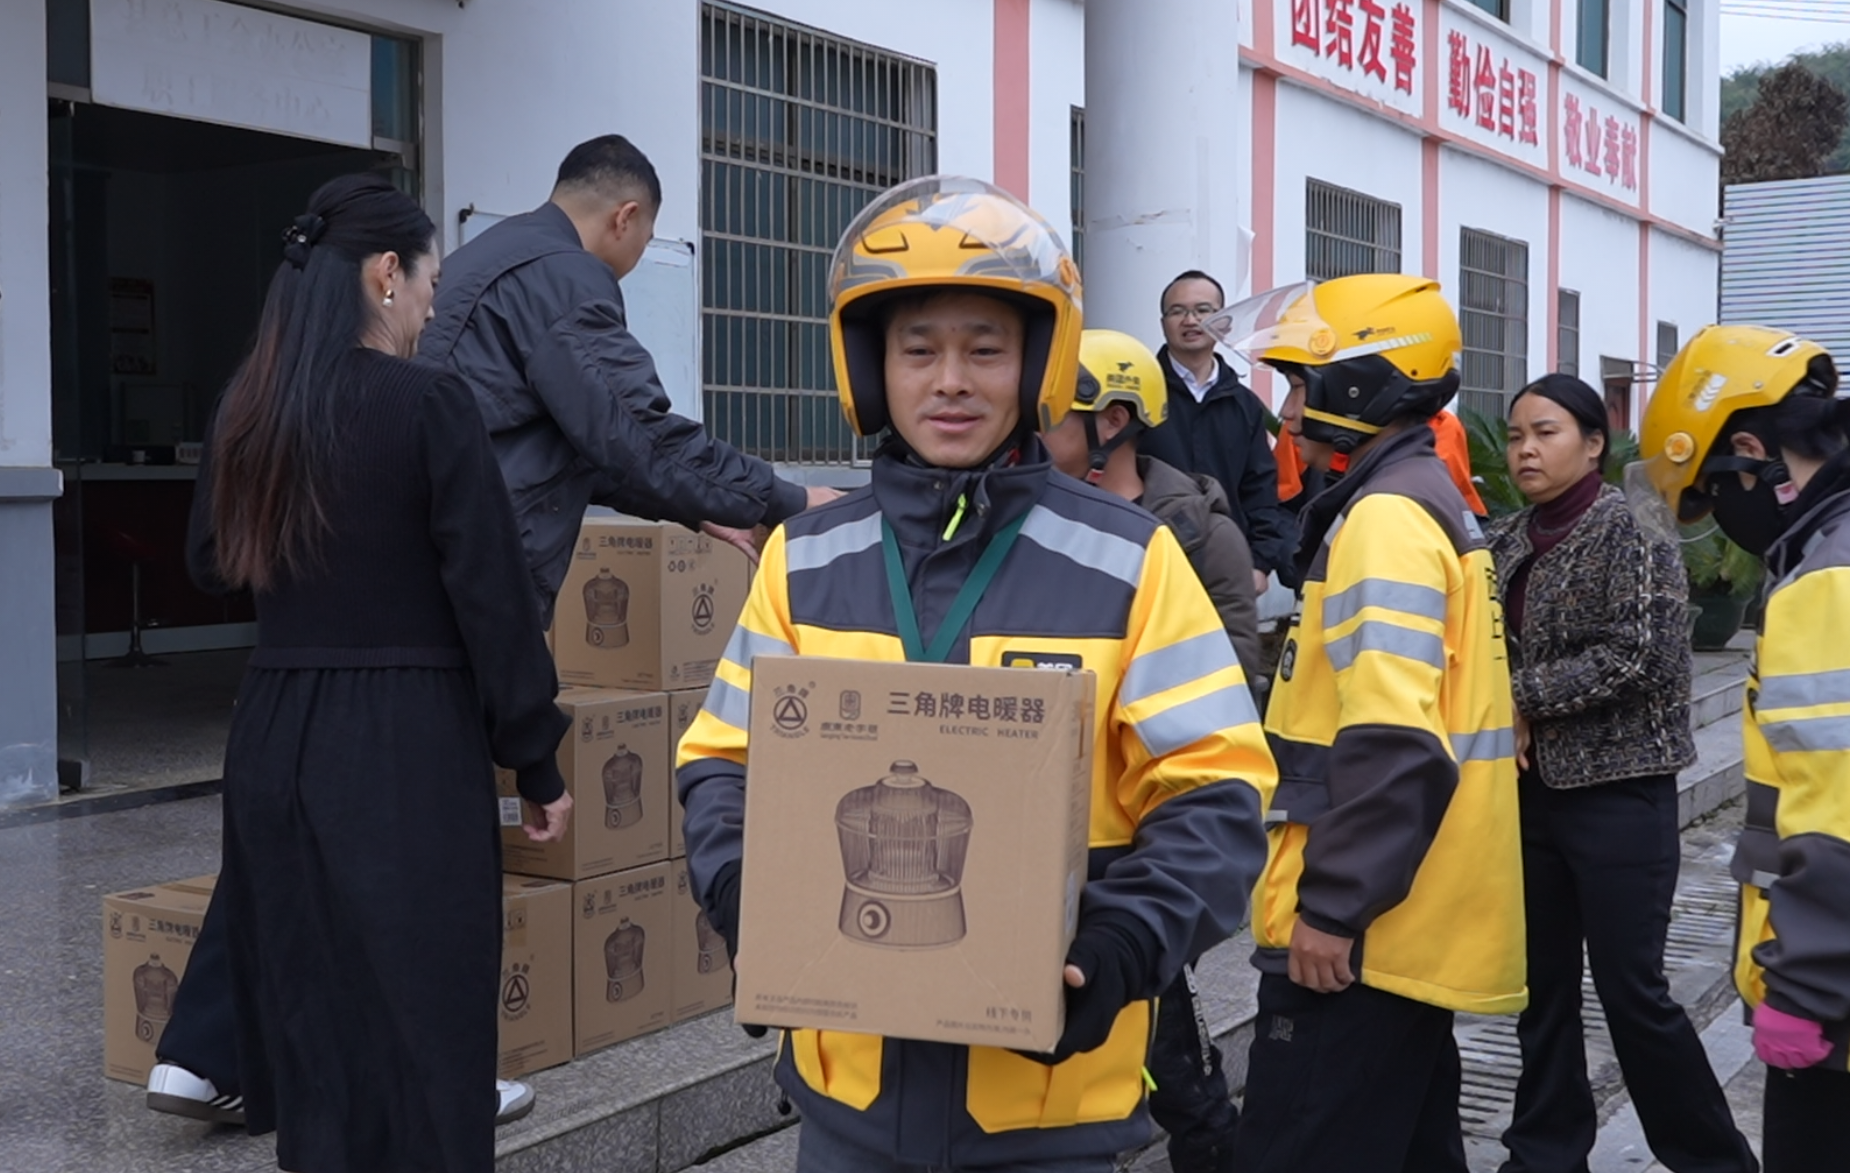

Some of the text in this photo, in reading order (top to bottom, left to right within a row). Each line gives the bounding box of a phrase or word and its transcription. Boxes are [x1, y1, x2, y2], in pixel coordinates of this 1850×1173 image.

[1291, 0, 1416, 96] 团结友善
[1447, 29, 1538, 147] 勤俭自强
[1564, 91, 1637, 192] 敬业奉献
[887, 691, 1046, 724] 三角牌电暖器
[939, 724, 1039, 740] ELECTRIC HEATER
